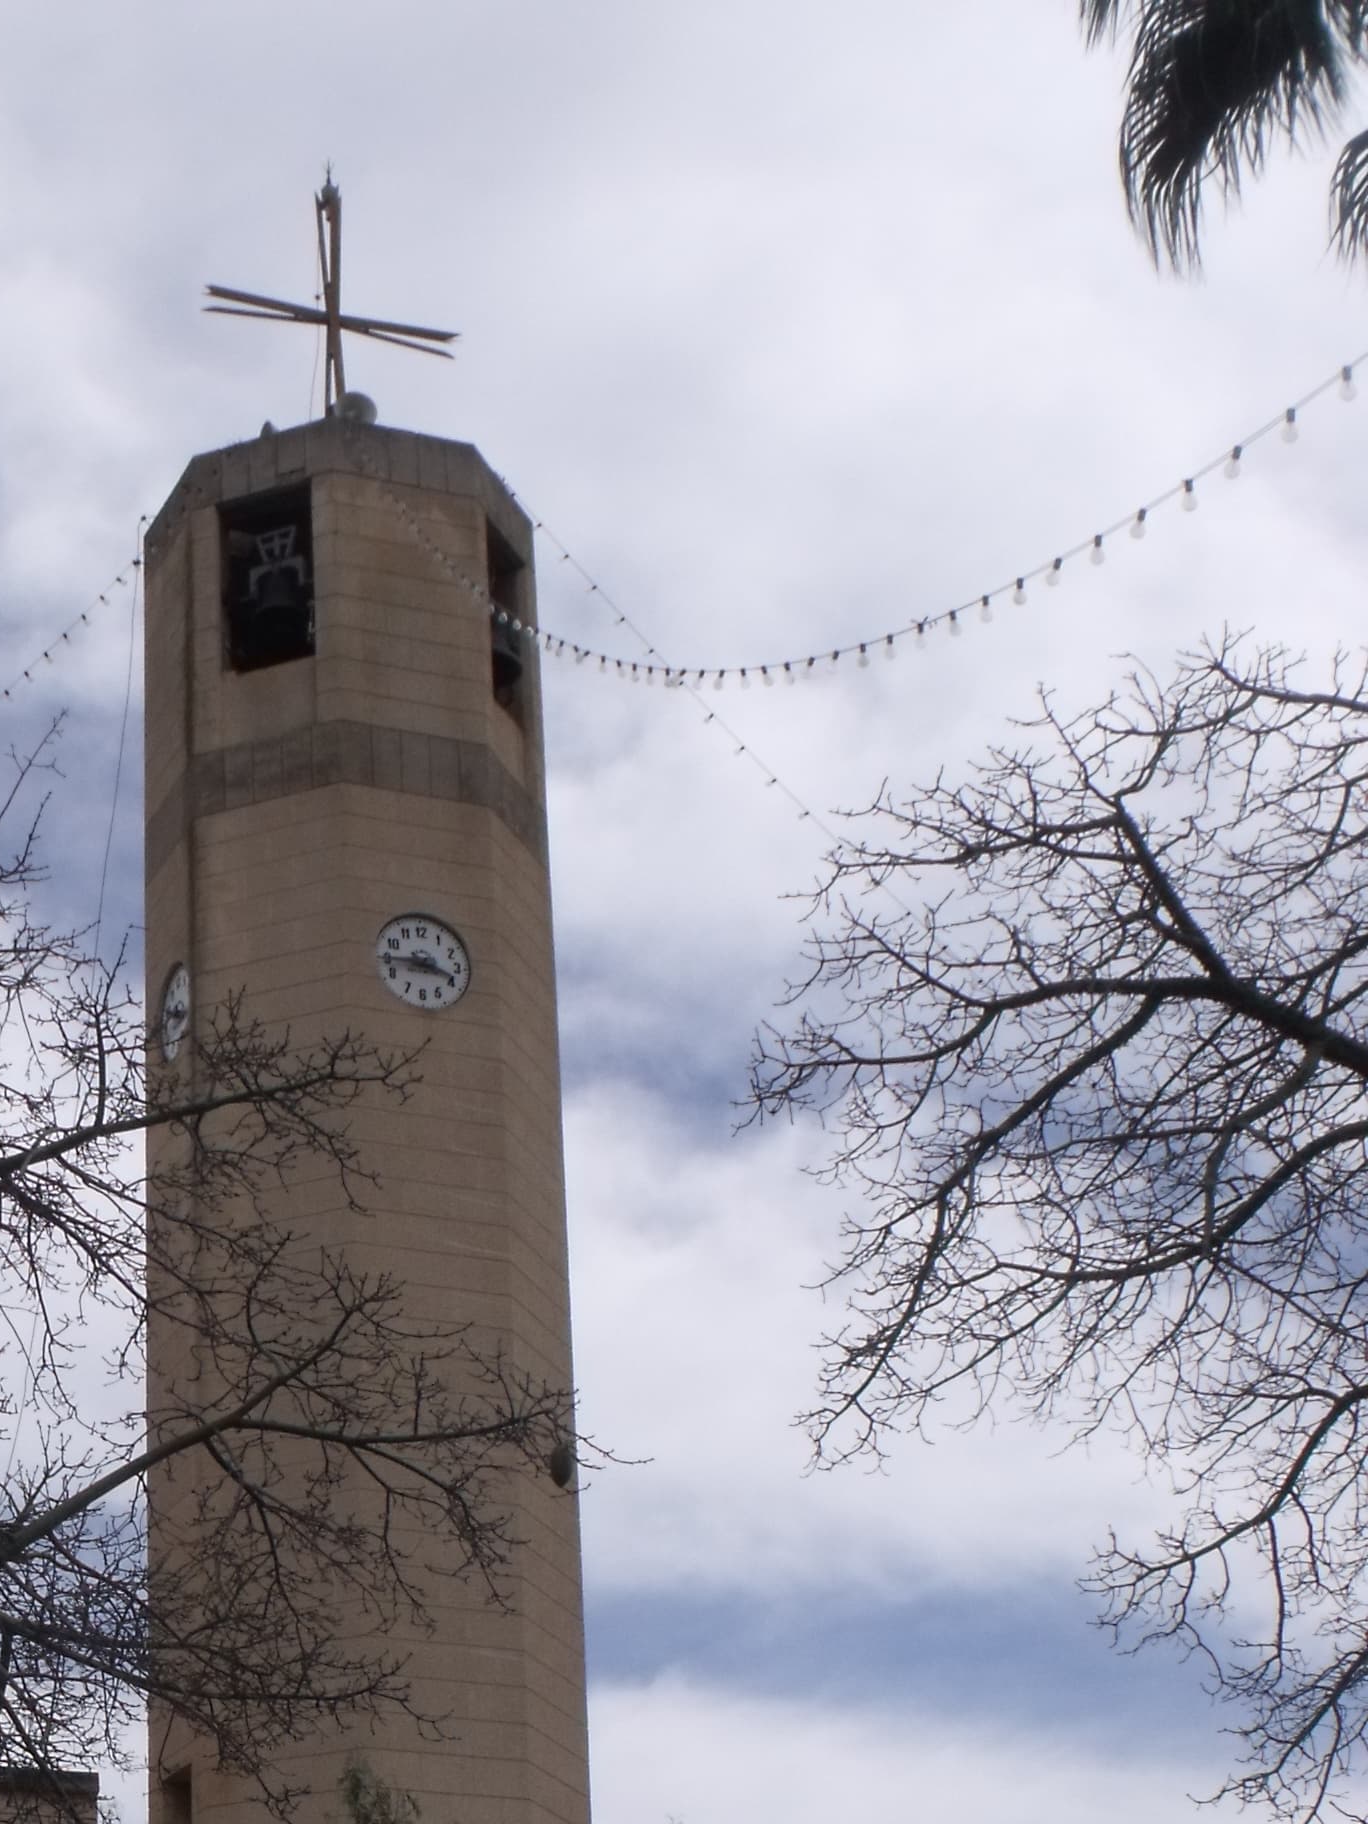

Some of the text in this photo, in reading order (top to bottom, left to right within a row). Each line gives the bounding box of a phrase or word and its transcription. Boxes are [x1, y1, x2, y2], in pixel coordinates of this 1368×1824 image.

[401, 928, 410, 939] 11
[416, 927, 427, 938] 12
[388, 938, 399, 950] 10
[448, 948, 455, 959] 2
[389, 967, 396, 979] 8
[454, 963, 461, 974] 3
[447, 976, 455, 987] 4
[405, 982, 411, 993] 7
[434, 987, 442, 998] 5
[419, 989, 427, 1000] 6
